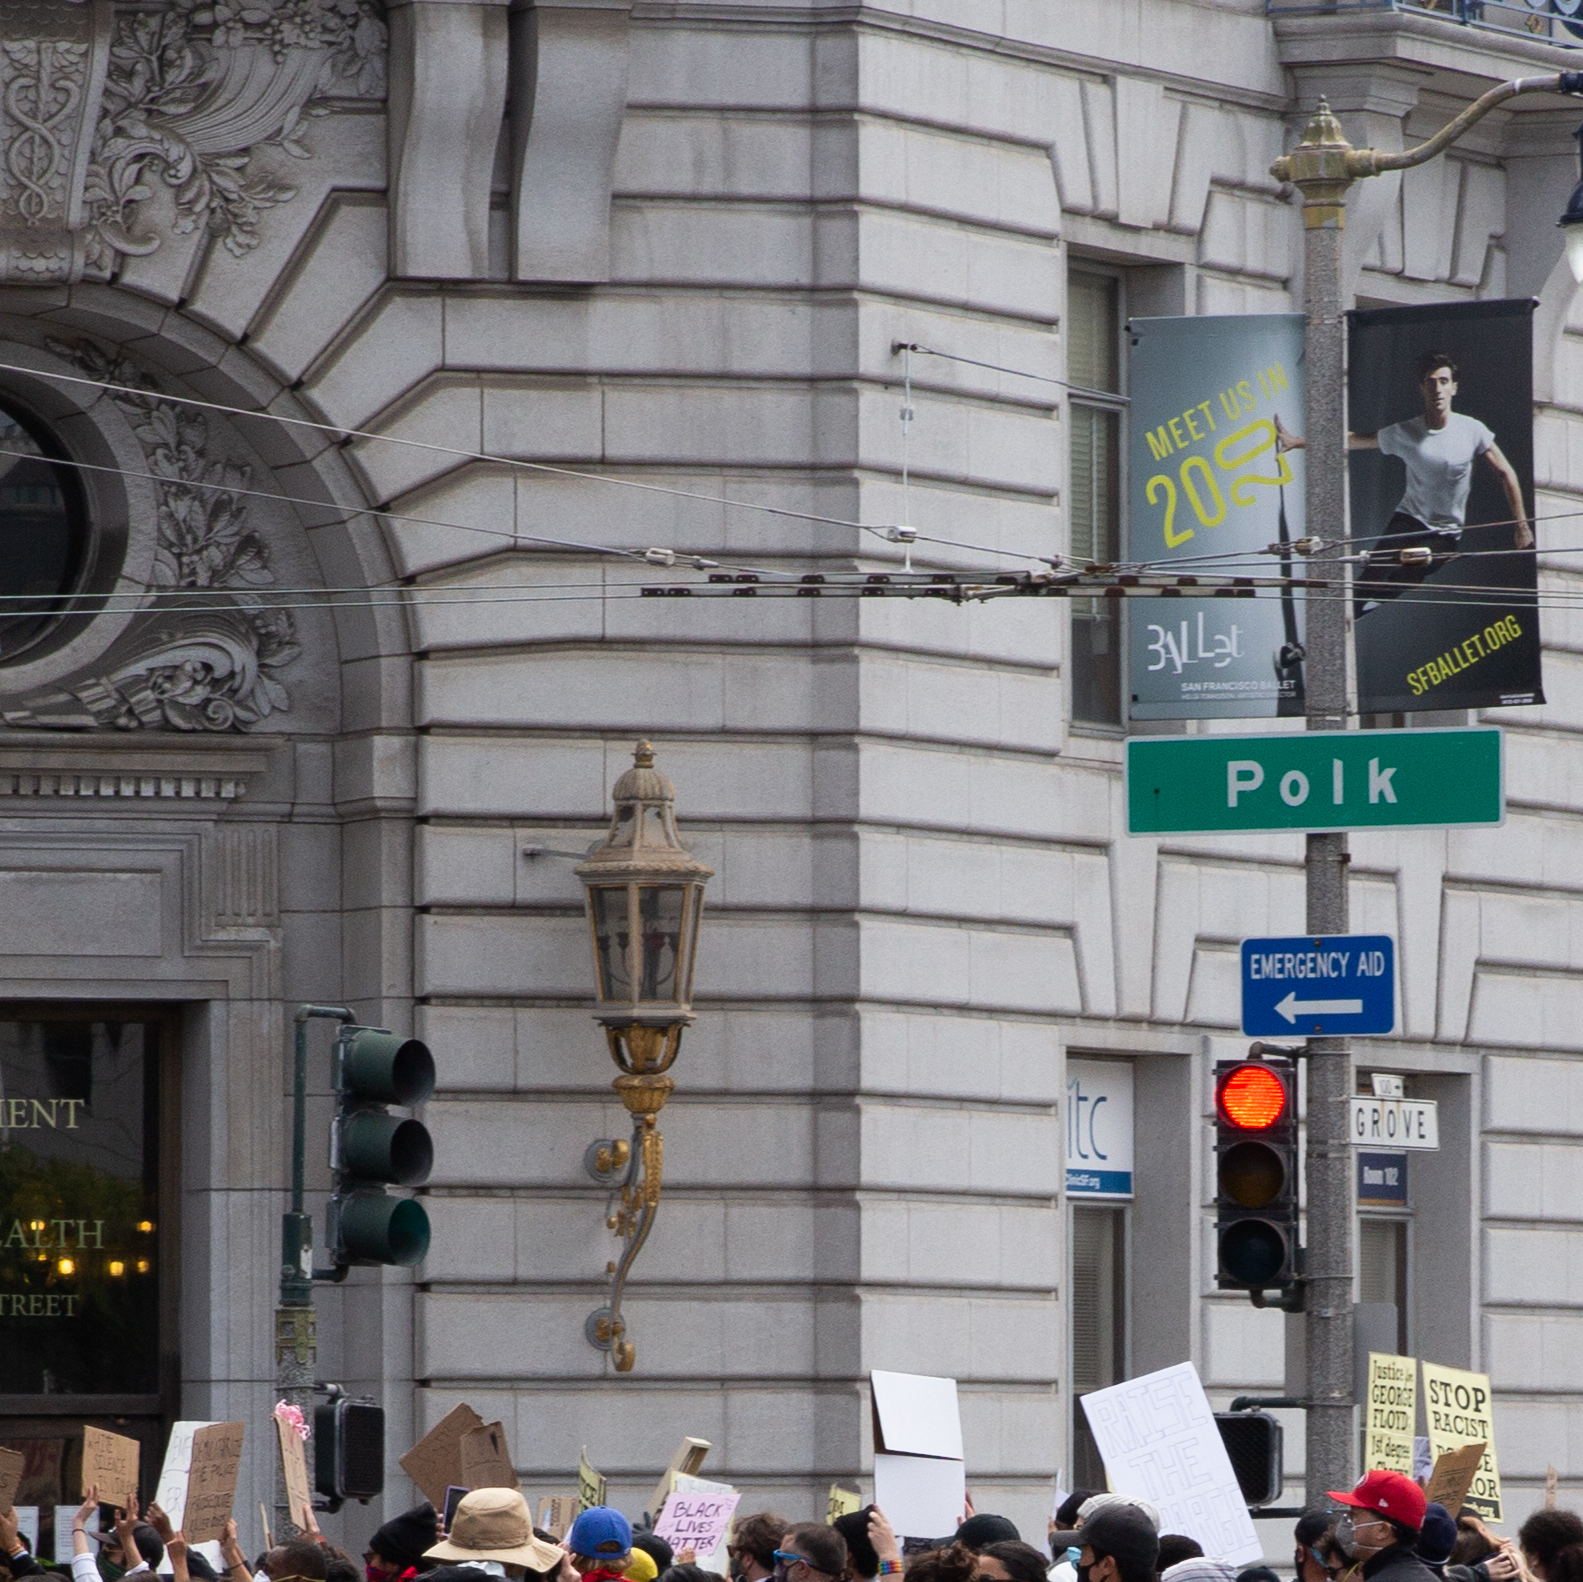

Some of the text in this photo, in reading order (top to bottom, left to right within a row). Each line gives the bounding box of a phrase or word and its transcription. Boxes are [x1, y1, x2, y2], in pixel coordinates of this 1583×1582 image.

[1145, 362, 1289, 461] MEET US IN
[1406, 614, 1523, 696] SFBALLET.ORG
[1181, 682, 1202, 692] SAN
[1204, 681, 1258, 691] FRANCISCO
[1227, 757, 1398, 808] Polk
[1250, 950, 1386, 980] EMERGENCY AID
[1356, 1107, 1426, 1139] GROVE
[1373, 1360, 1404, 1384] Justice
[1372, 1384, 1414, 1408] GEORGE
[1429, 1379, 1486, 1413] STOP
[1090, 1370, 1209, 1459] RAISE
[1432, 1410, 1489, 1440] RACIST
[1128, 1437, 1213, 1503] THE
[672, 1501, 724, 1519] BLACK
[674, 1519, 715, 1534] LIVES
